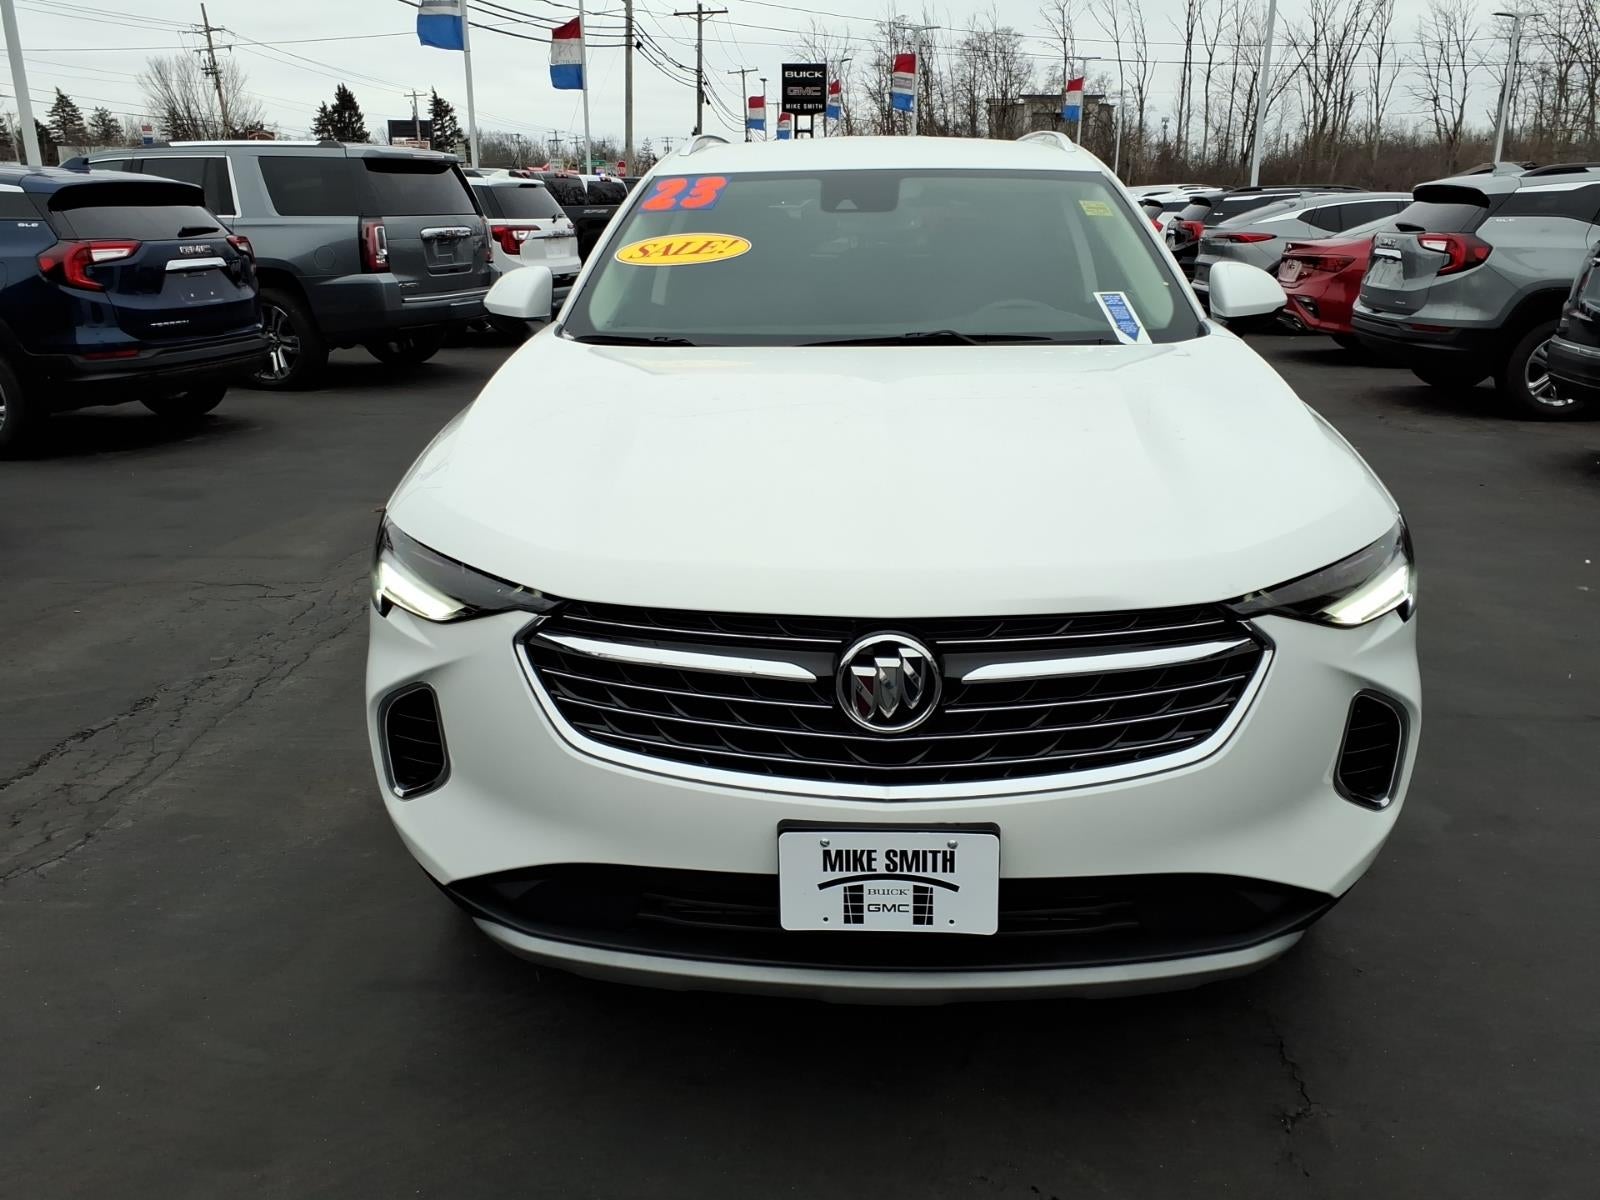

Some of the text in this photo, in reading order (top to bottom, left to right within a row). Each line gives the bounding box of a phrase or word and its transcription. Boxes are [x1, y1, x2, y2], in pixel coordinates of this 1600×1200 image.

[786, 86, 822, 96] GMC
[641, 176, 727, 211] 23
[628, 239, 740, 259] SALE!
[822, 849, 956, 874] MIKE SMITH
[867, 888, 910, 896] BUICK
[867, 903, 910, 913] GMC
